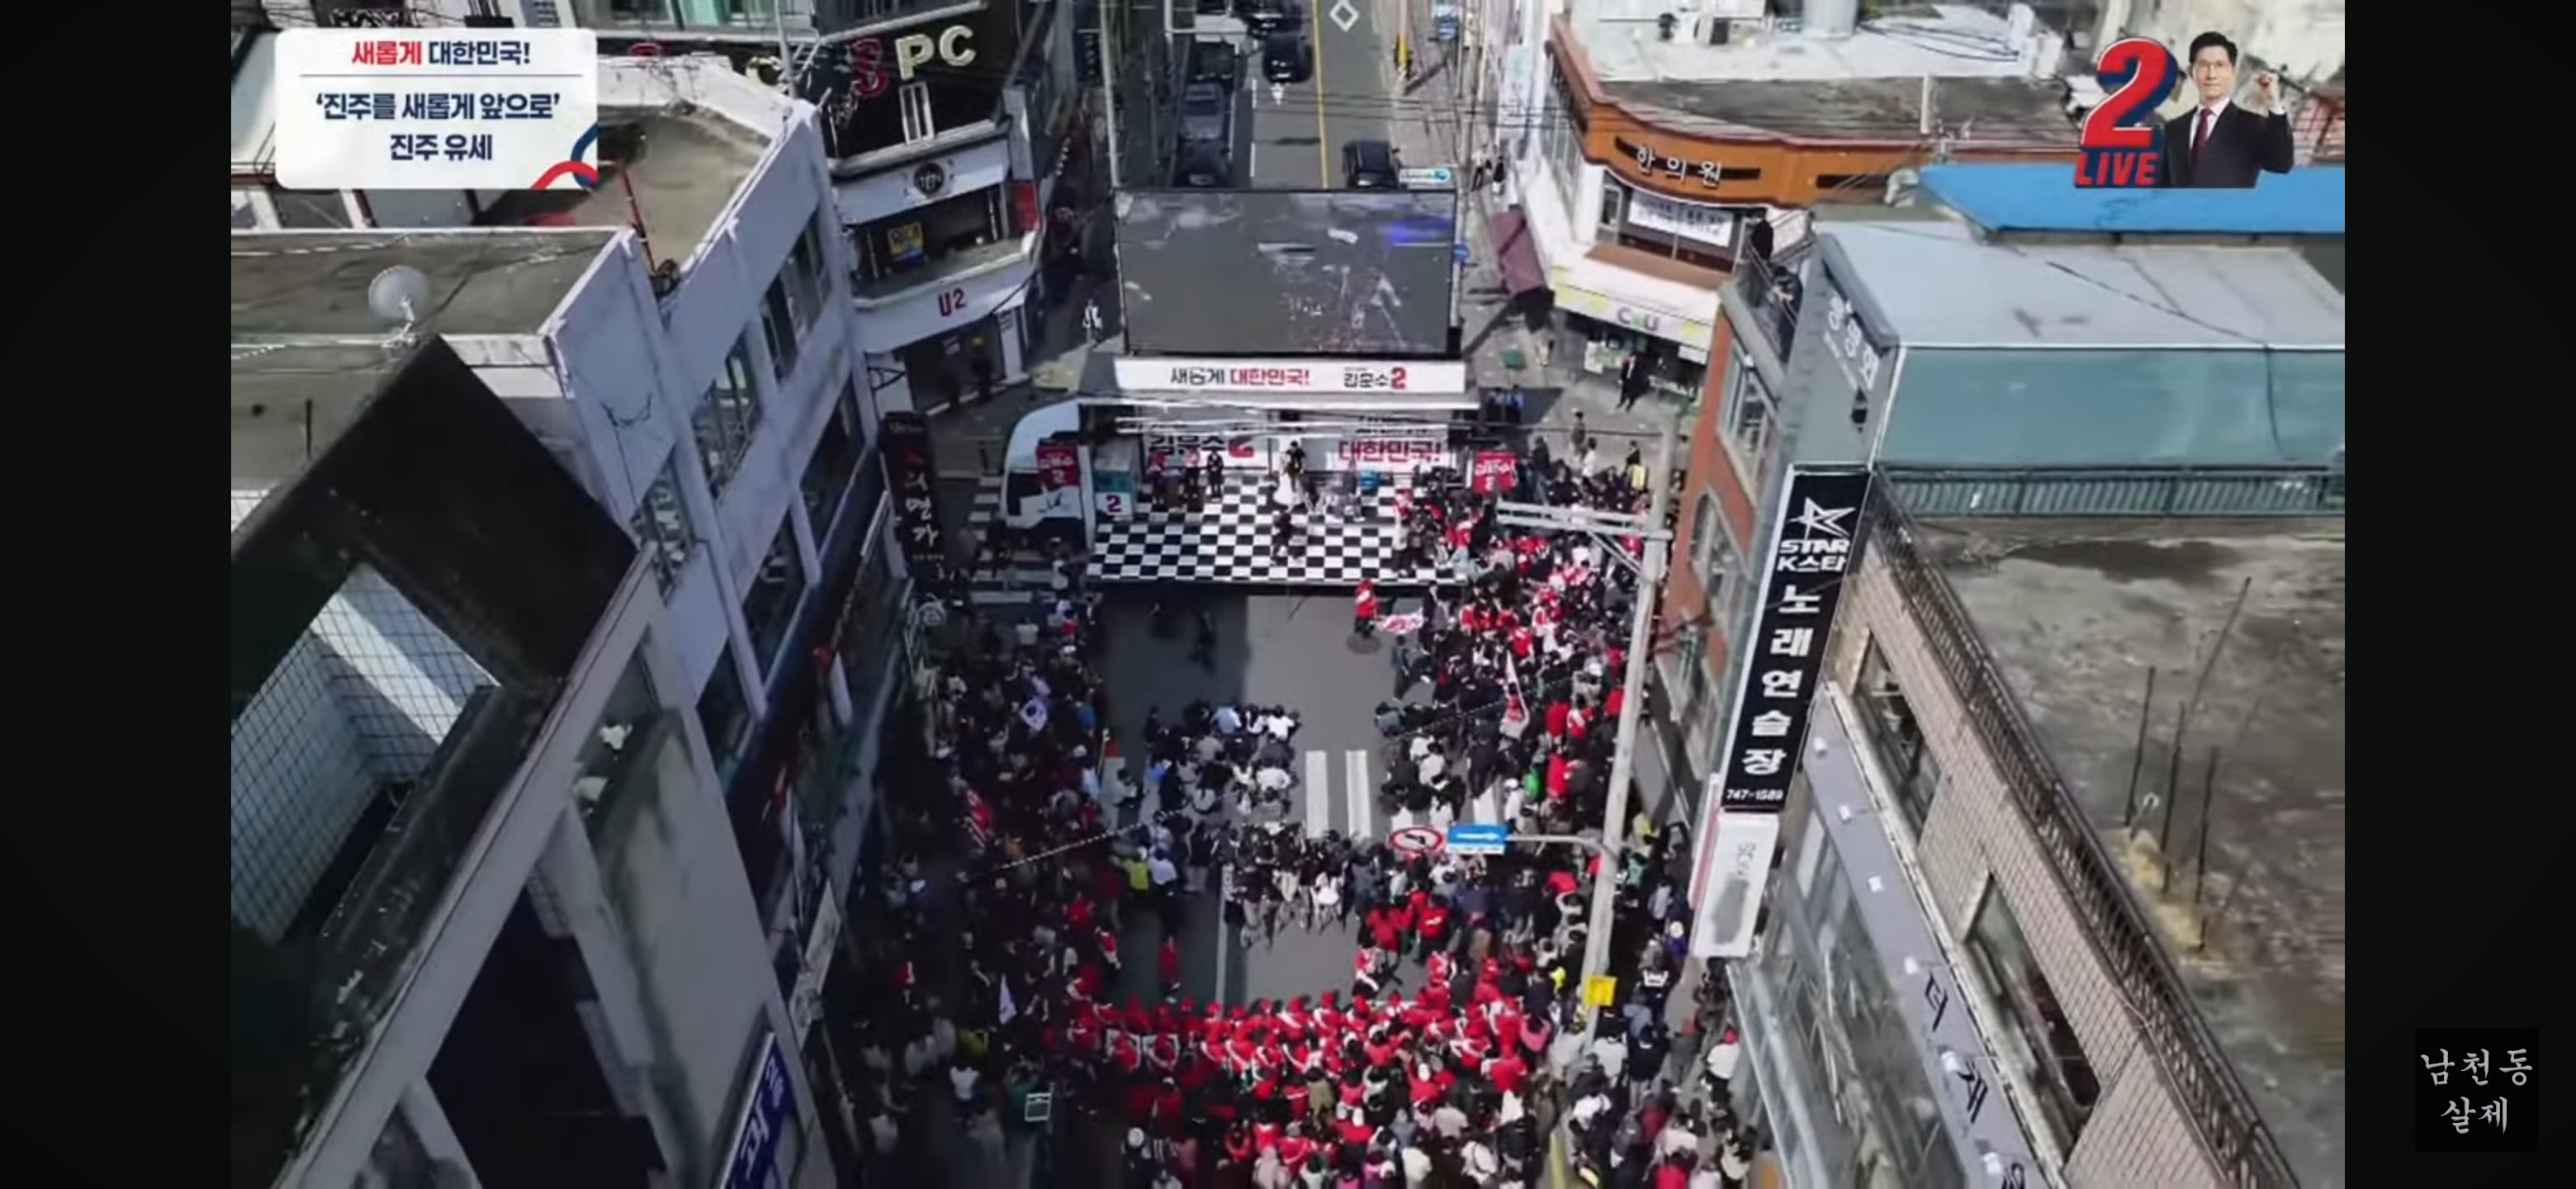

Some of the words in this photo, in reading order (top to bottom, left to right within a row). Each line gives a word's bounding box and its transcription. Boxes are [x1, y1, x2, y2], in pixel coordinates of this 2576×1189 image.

[896, 26, 976, 80] PC
[1637, 144, 1721, 188] 한의원
[938, 289, 966, 316] U2
[1106, 495, 1121, 512] 2
[1778, 538, 1850, 553] STAR
[1777, 556, 1847, 572] K스타
[1742, 585, 1821, 776] 노래연습장
